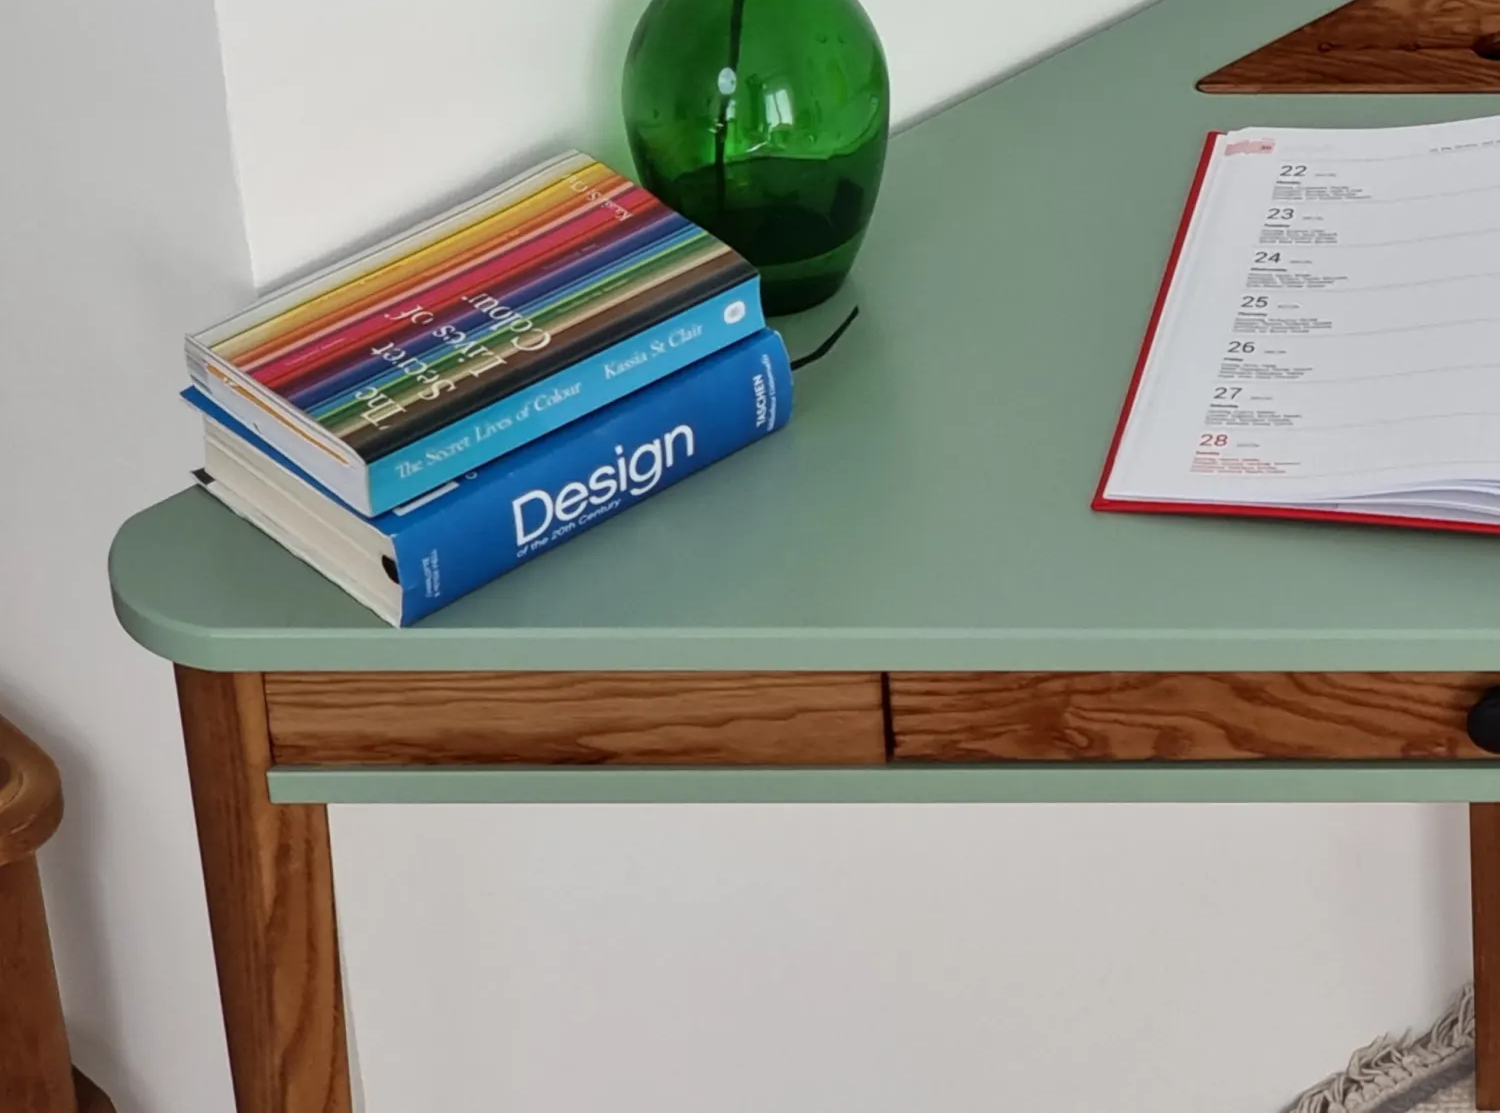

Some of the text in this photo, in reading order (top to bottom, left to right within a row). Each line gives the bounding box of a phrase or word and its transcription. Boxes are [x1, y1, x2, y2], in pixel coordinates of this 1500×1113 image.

[1279, 164, 1308, 177] 22
[1266, 207, 1295, 220] 23
[1253, 251, 1281, 264] 24
[461, 292, 551, 352] Colour
[1240, 295, 1269, 308] 25
[384, 304, 508, 378] Lives of
[602, 324, 705, 380] Kassia St Clair
[1226, 341, 1256, 354] 26
[370, 342, 456, 401] Secret
[1213, 387, 1243, 400] 27
[355, 386, 406, 431] The
[752, 374, 767, 428] TASCHEN
[394, 381, 583, 480] The Secret Lives of Colour
[1199, 433, 1229, 447] 28
[511, 423, 695, 547] Design
[516, 497, 623, 558] of the 20th Century
